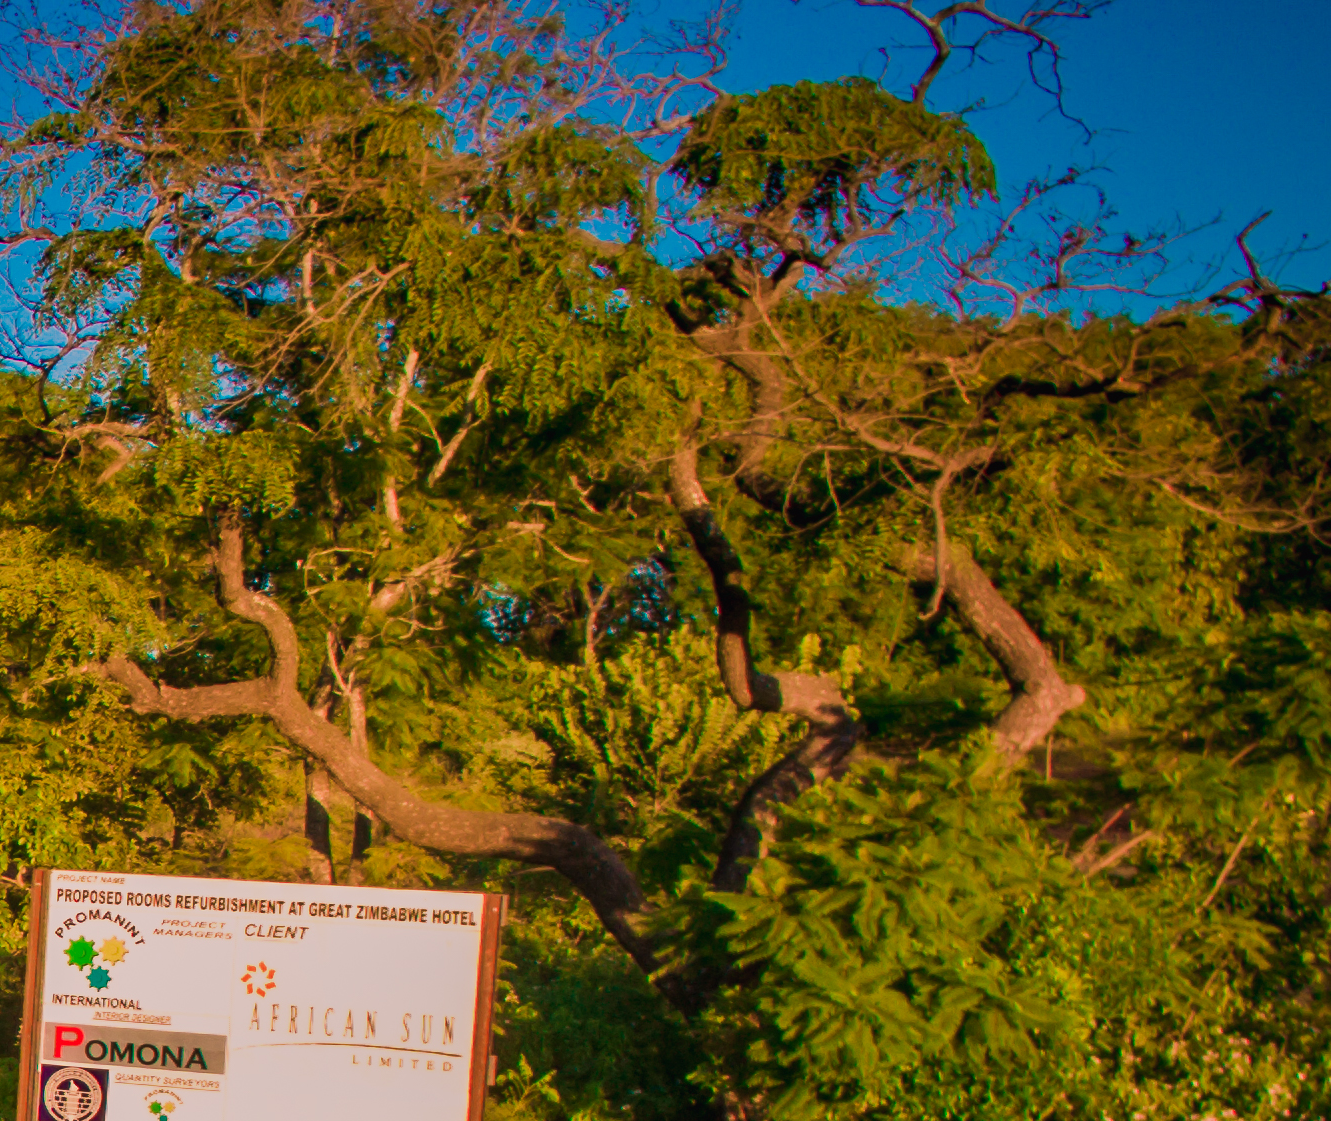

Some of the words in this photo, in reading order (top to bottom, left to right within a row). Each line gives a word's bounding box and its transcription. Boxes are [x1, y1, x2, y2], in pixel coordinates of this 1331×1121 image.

[56, 888, 122, 905] PROPOSED
[127, 892, 172, 908] ROOMS
[175, 894, 285, 915] REFURBISHMENT
[288, 901, 305, 916] AT
[309, 902, 352, 919] GREAT
[356, 905, 428, 923] ZIMBABWE
[432, 909, 477, 927] HOTEL
[54, 909, 146, 945] PROMANINT
[161, 919, 227, 930] PROJECT
[244, 923, 310, 940] CLIENT
[153, 928, 234, 940] MANAGERS
[52, 993, 142, 1010] INTERNATIONAL
[249, 1002, 378, 1039] AFRICAN
[401, 1012, 456, 1045] SUN
[53, 1025, 208, 1070] POMONA
[352, 1055, 453, 1072] LIMITED
